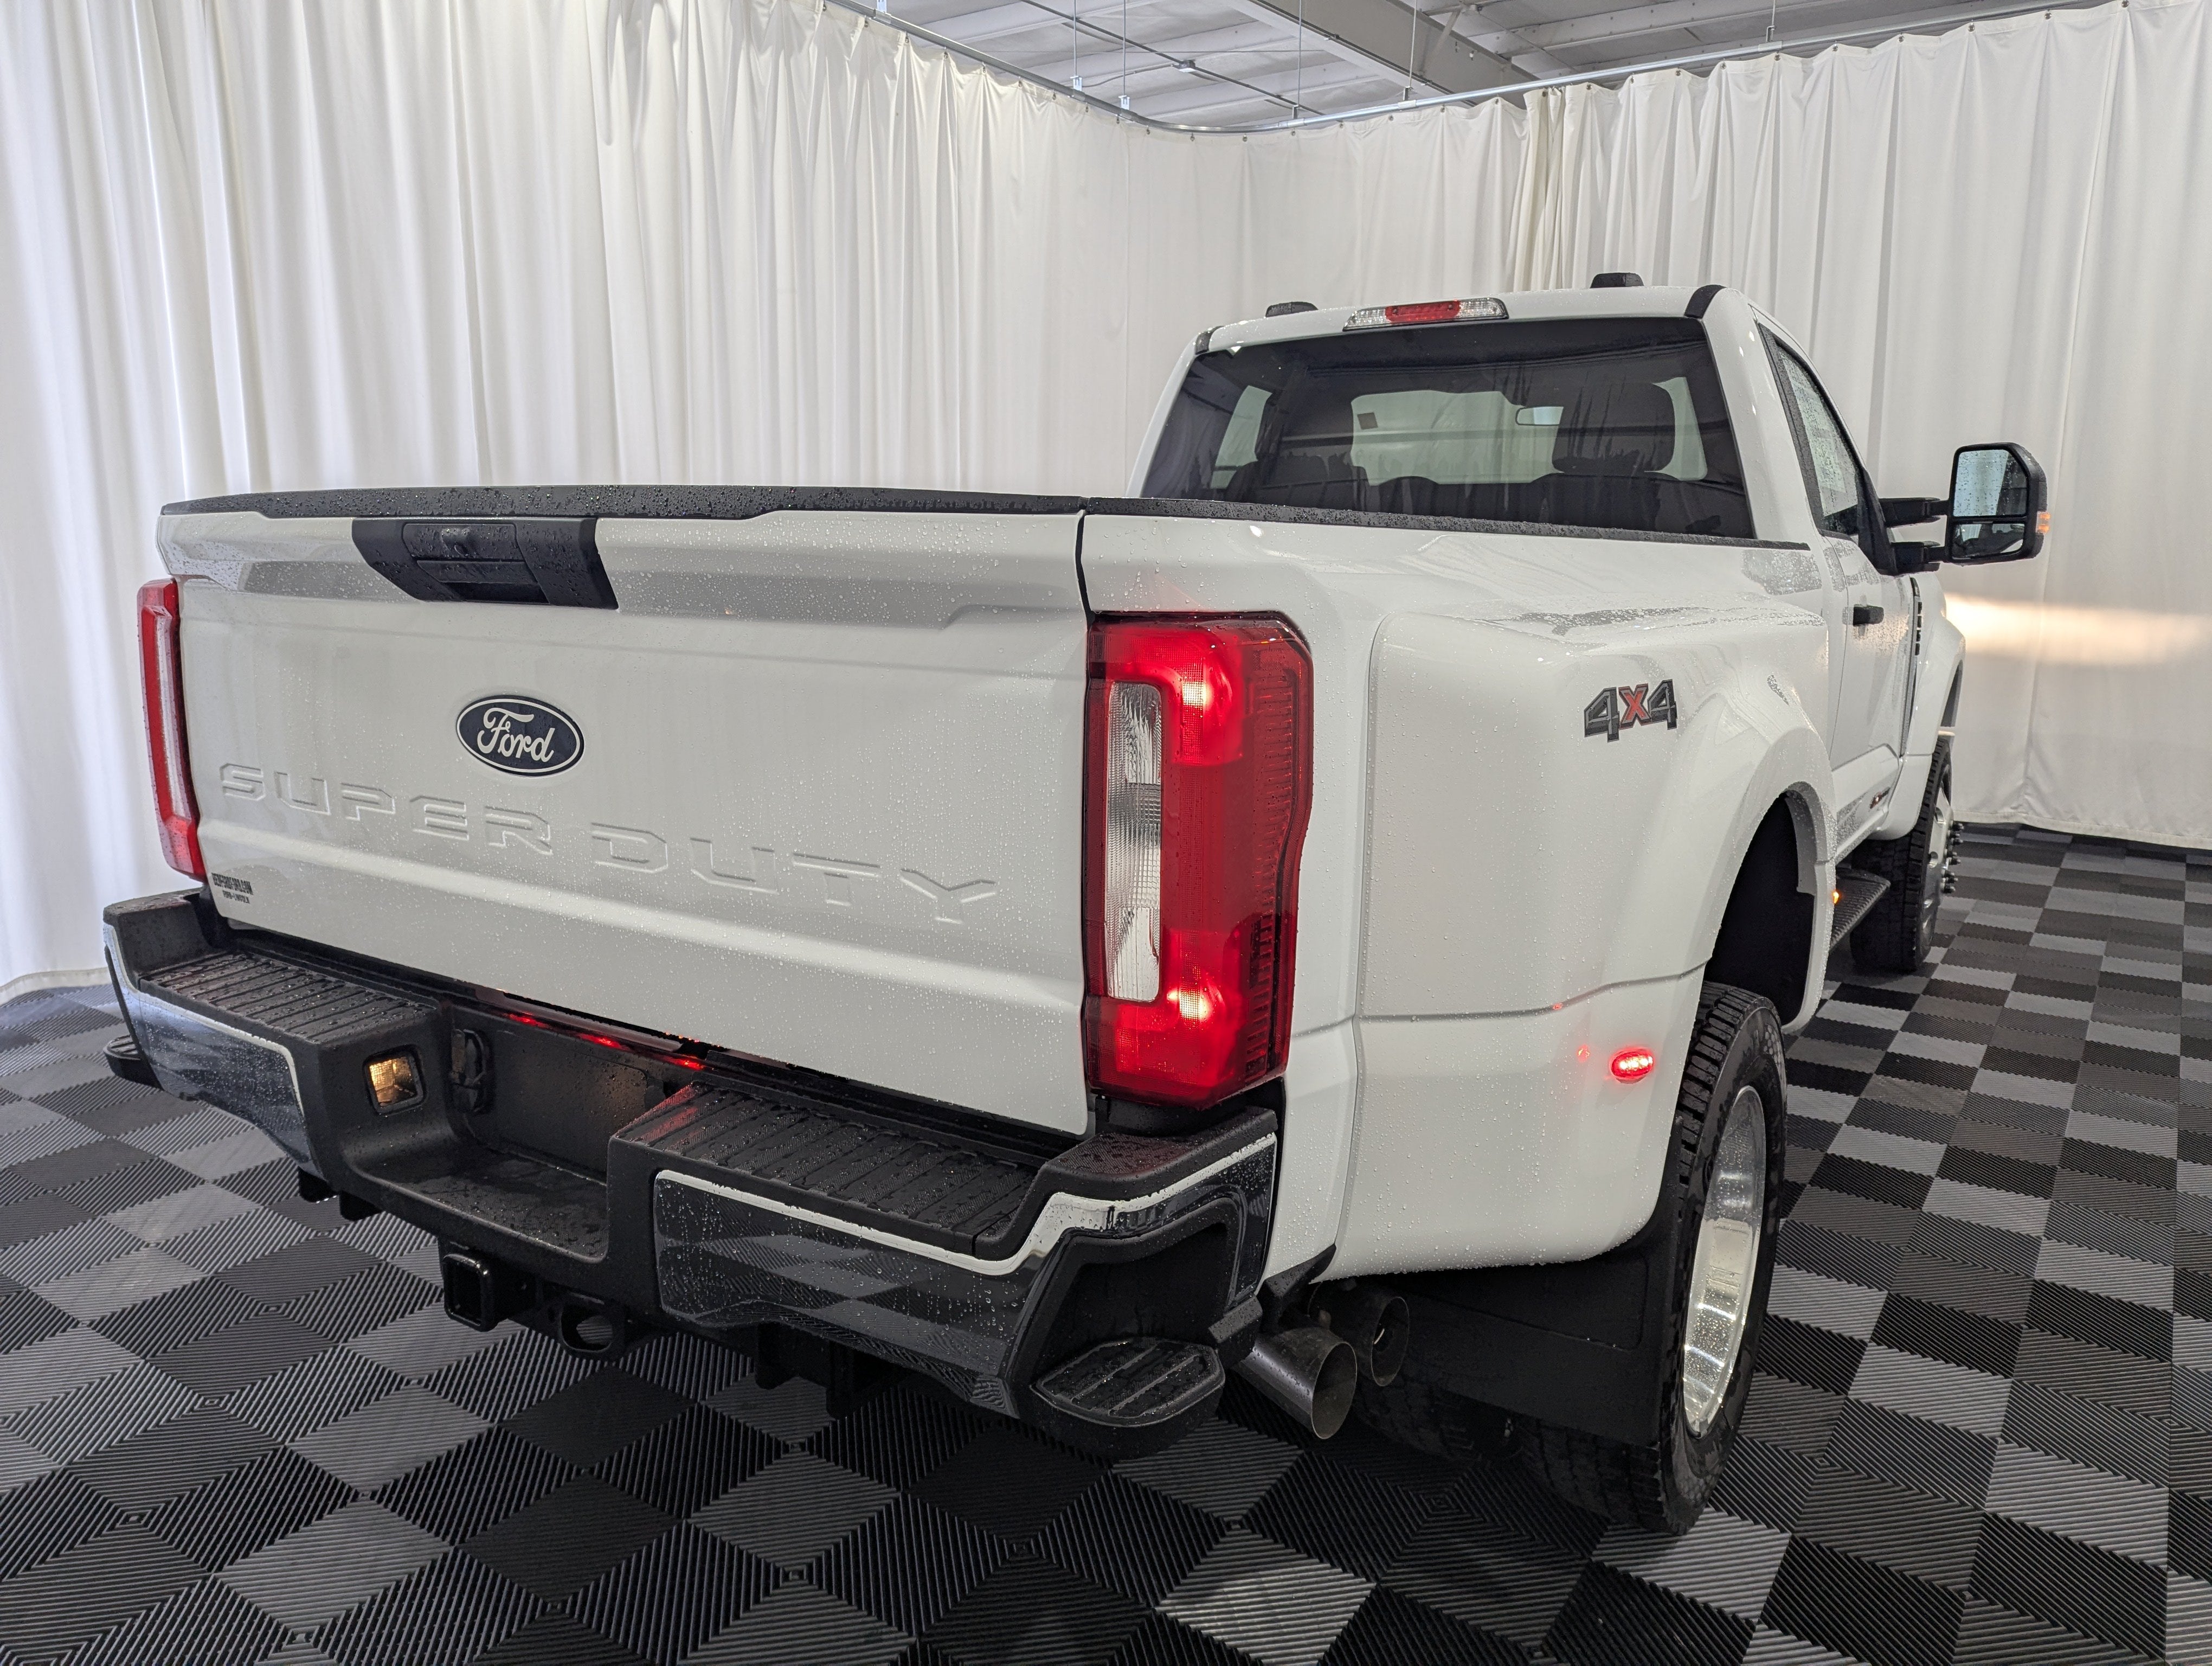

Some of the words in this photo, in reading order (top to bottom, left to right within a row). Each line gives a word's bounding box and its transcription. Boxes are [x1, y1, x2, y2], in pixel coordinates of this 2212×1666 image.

[477, 707, 556, 762] Ford
[219, 762, 554, 855] SUPER
[590, 822, 998, 925] DUTY
